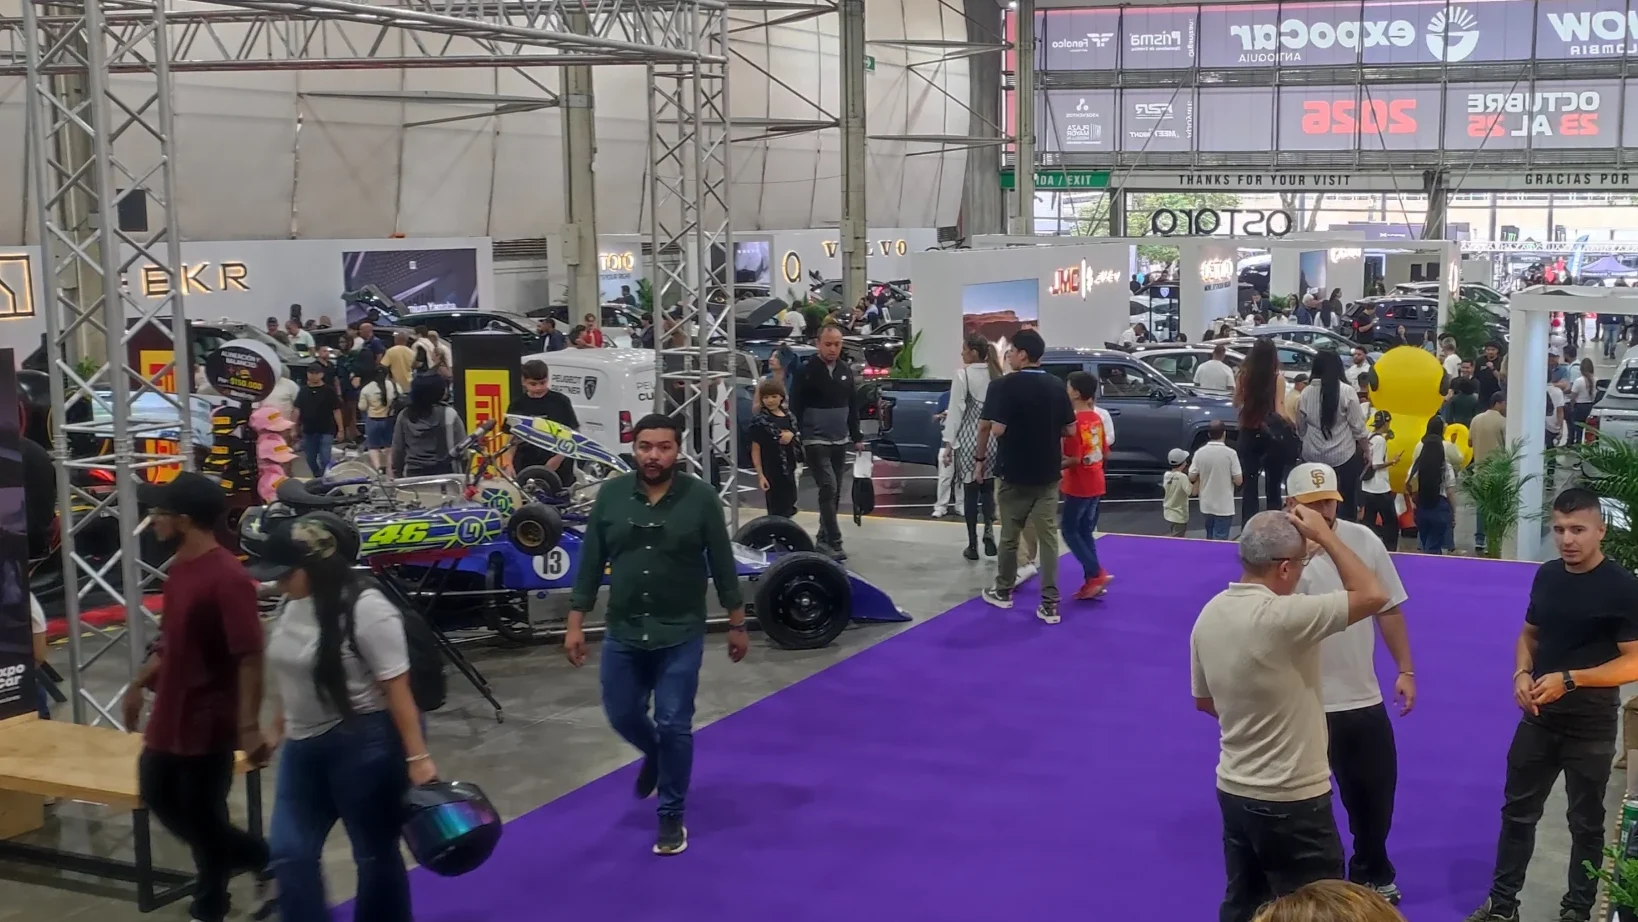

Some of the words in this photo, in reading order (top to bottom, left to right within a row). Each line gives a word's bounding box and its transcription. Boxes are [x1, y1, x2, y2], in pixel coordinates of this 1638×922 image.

[1066, 174, 1092, 185] EXIT
[1179, 174, 1230, 186] THANKS
[1238, 174, 1262, 186] FOR
[1271, 174, 1306, 186] YOUR
[1314, 174, 1351, 186] VISIT
[1525, 173, 1591, 185] GRACIAS
[1600, 173, 1629, 185] POR
[822, 239, 907, 259] VLVO
[368, 522, 429, 545] 46
[542, 551, 562, 574] 13
